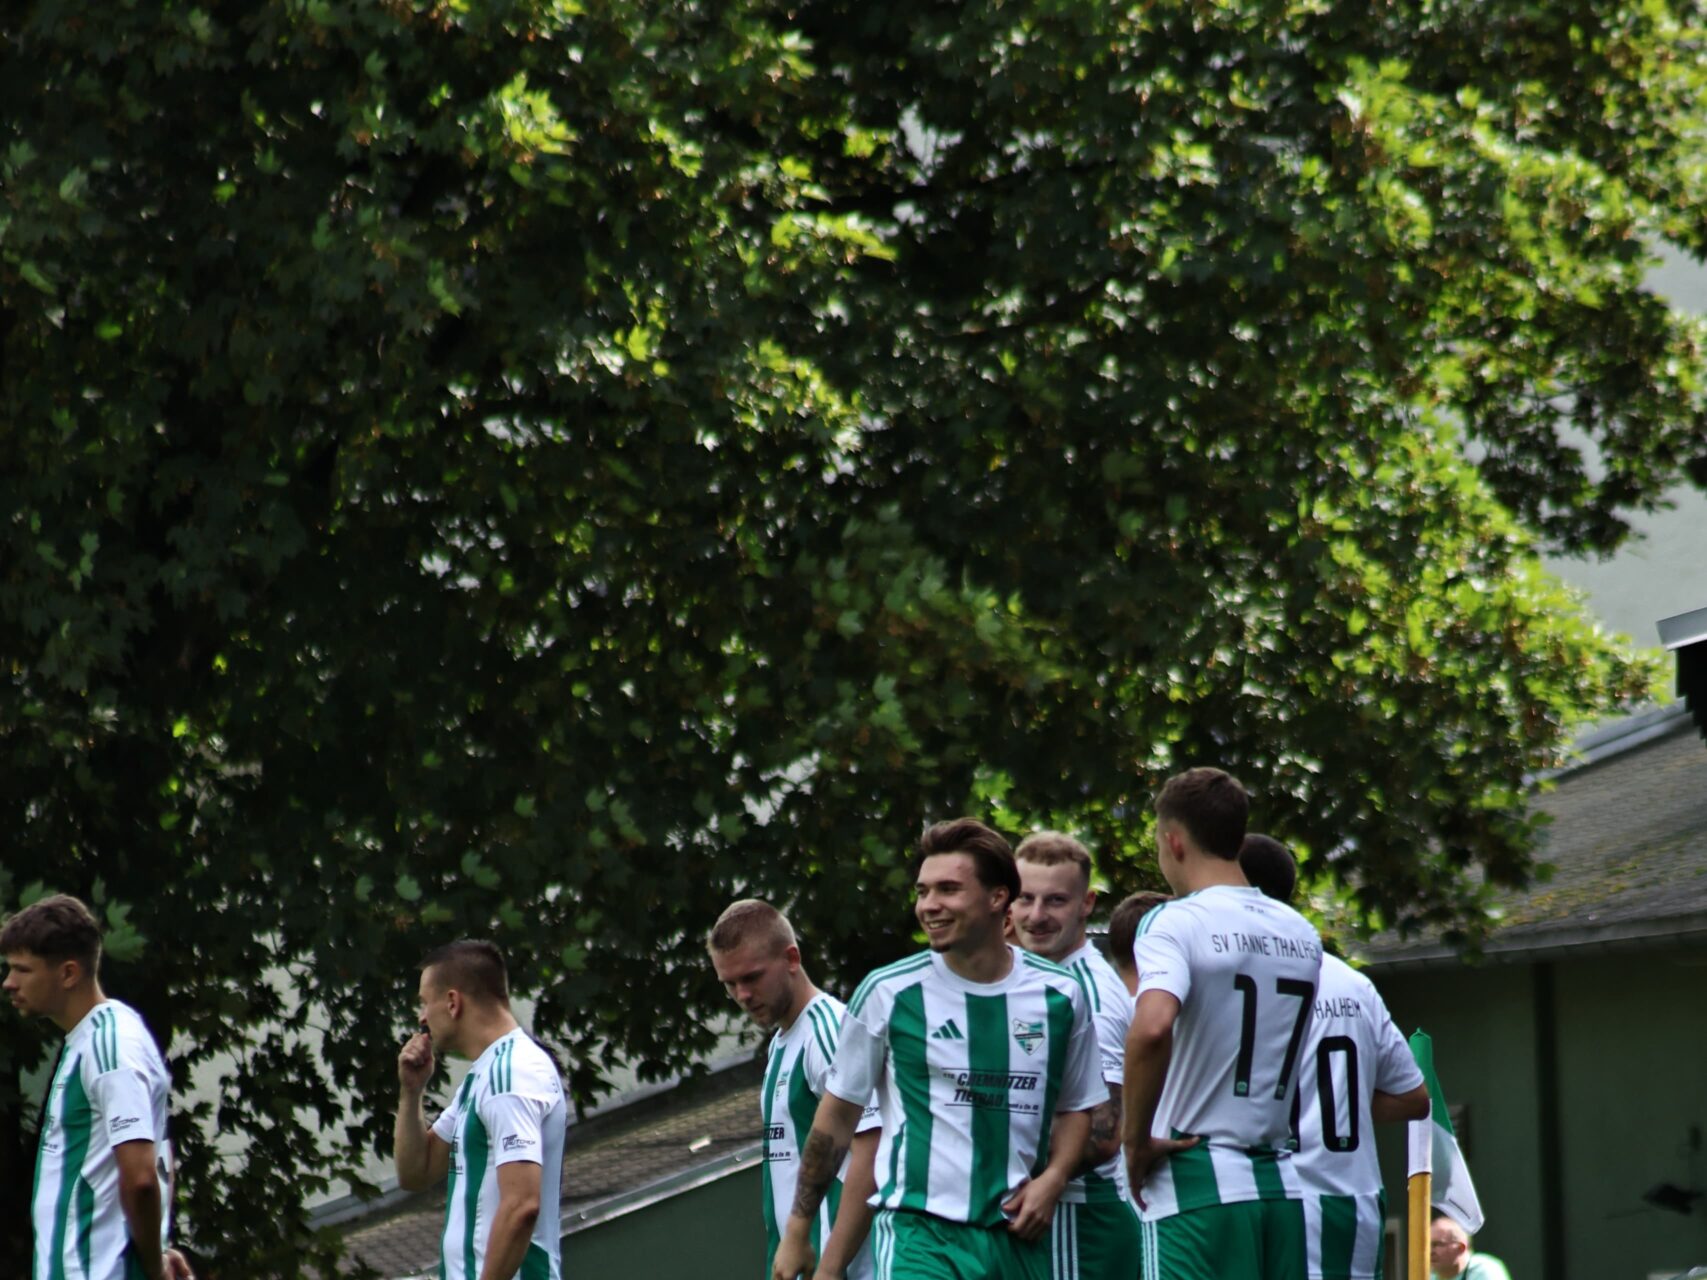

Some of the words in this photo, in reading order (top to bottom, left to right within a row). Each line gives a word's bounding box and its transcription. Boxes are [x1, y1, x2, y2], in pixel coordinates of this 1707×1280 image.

[1211, 934, 1230, 953] SV
[1233, 933, 1271, 956] TANNE
[1273, 936, 1320, 961] THALHE
[1313, 997, 1362, 1019] HALHEIM
[1233, 973, 1315, 1100] 17
